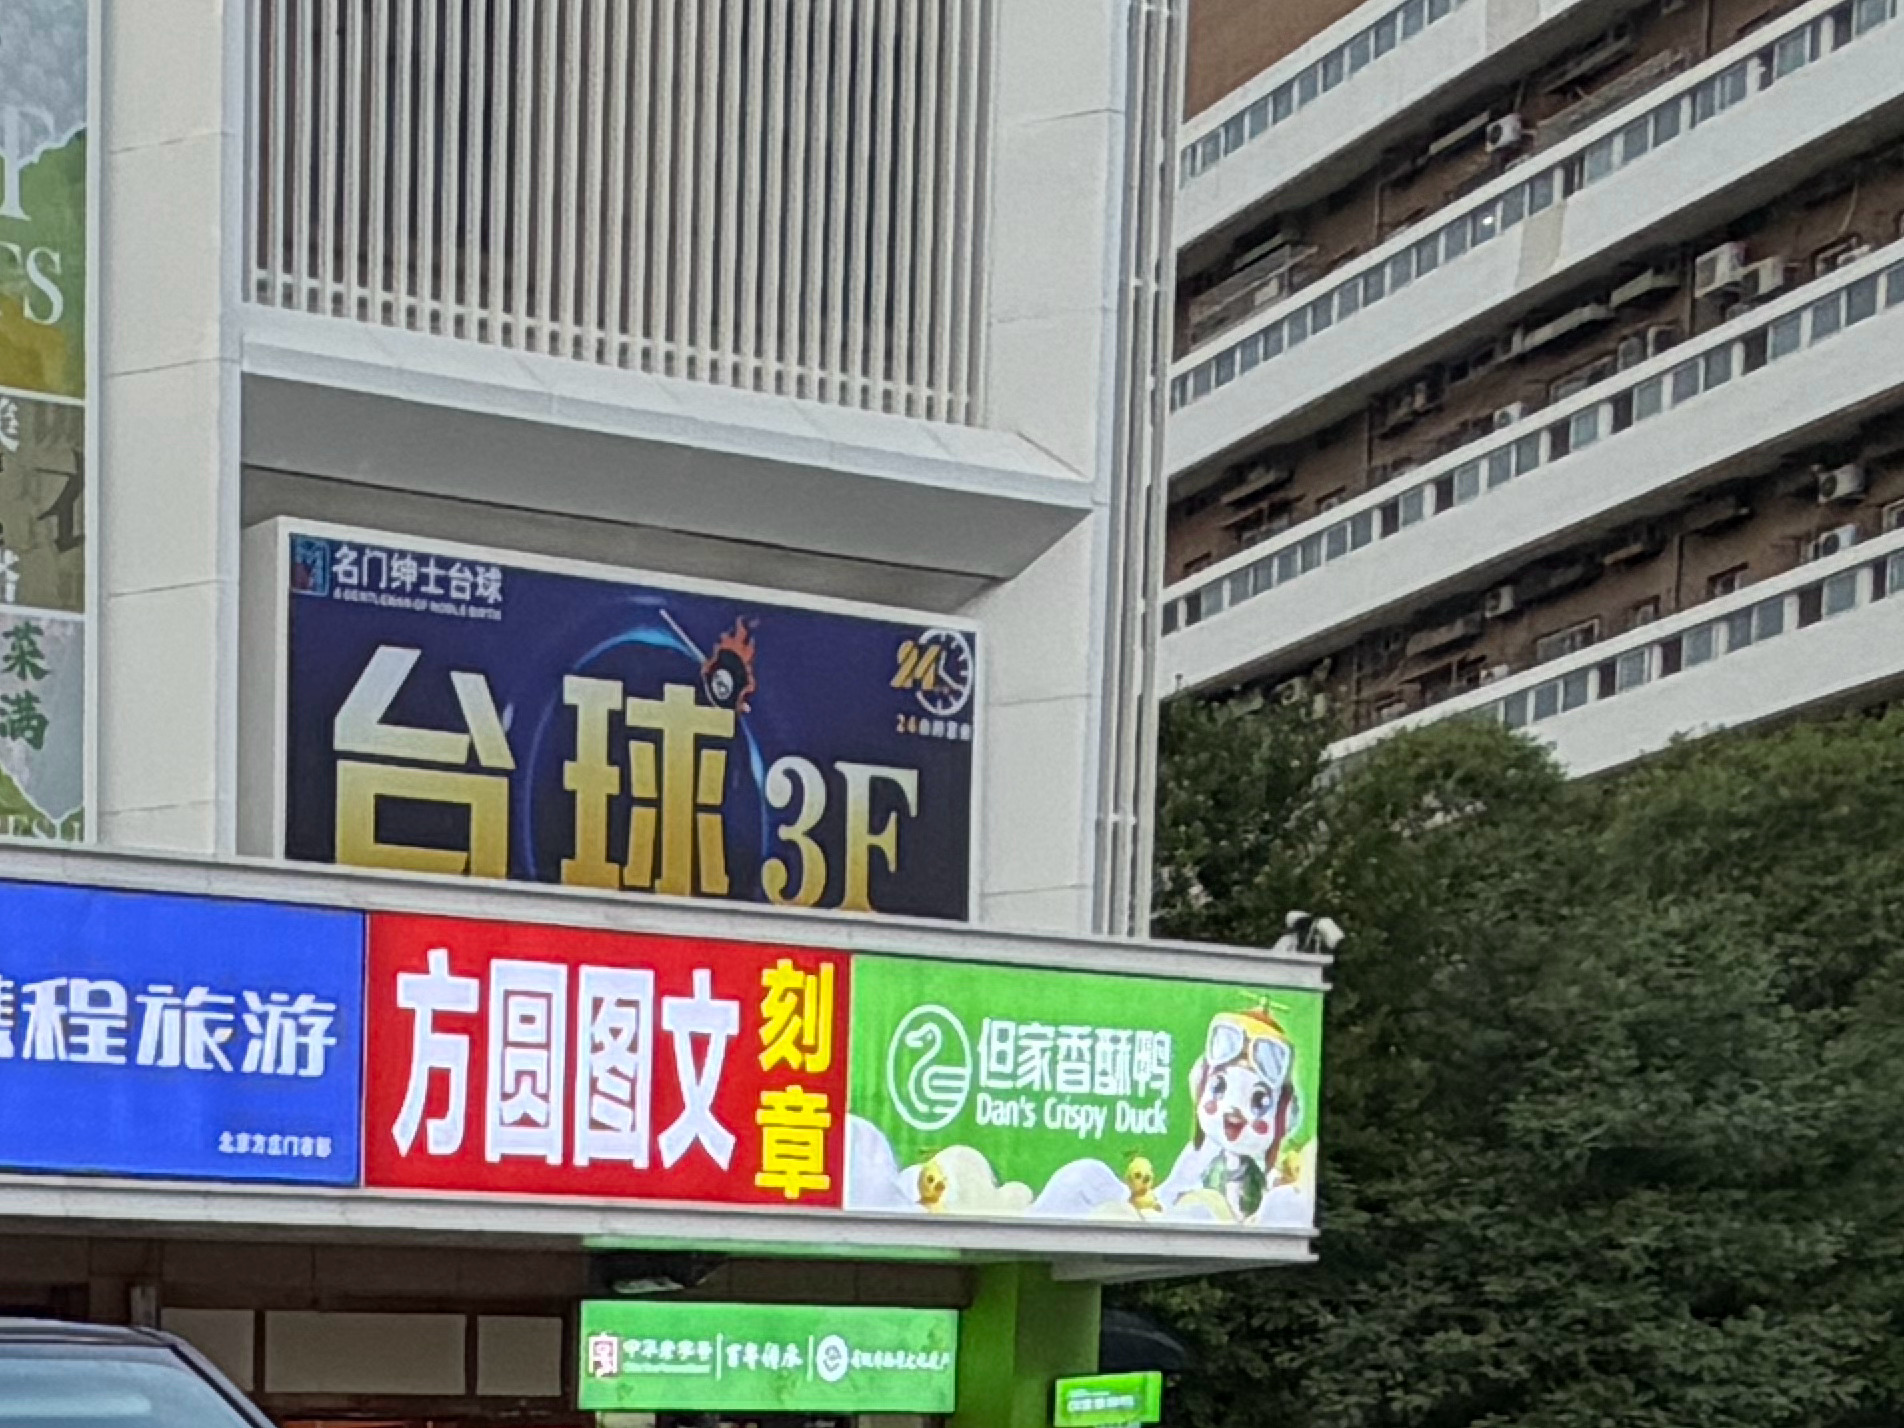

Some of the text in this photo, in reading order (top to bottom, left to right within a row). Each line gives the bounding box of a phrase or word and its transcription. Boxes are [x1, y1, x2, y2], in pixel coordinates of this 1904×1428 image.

[332, 544, 503, 604] 名门绅士台球
[332, 645, 919, 912] 台球 3F
[391, 947, 740, 1172] 方圆图文
[754, 957, 837, 1199] 刻章
[976, 1093, 1169, 1139] Dan's Crispy Duck
[977, 1016, 1171, 1099] 但家香酥鸭
